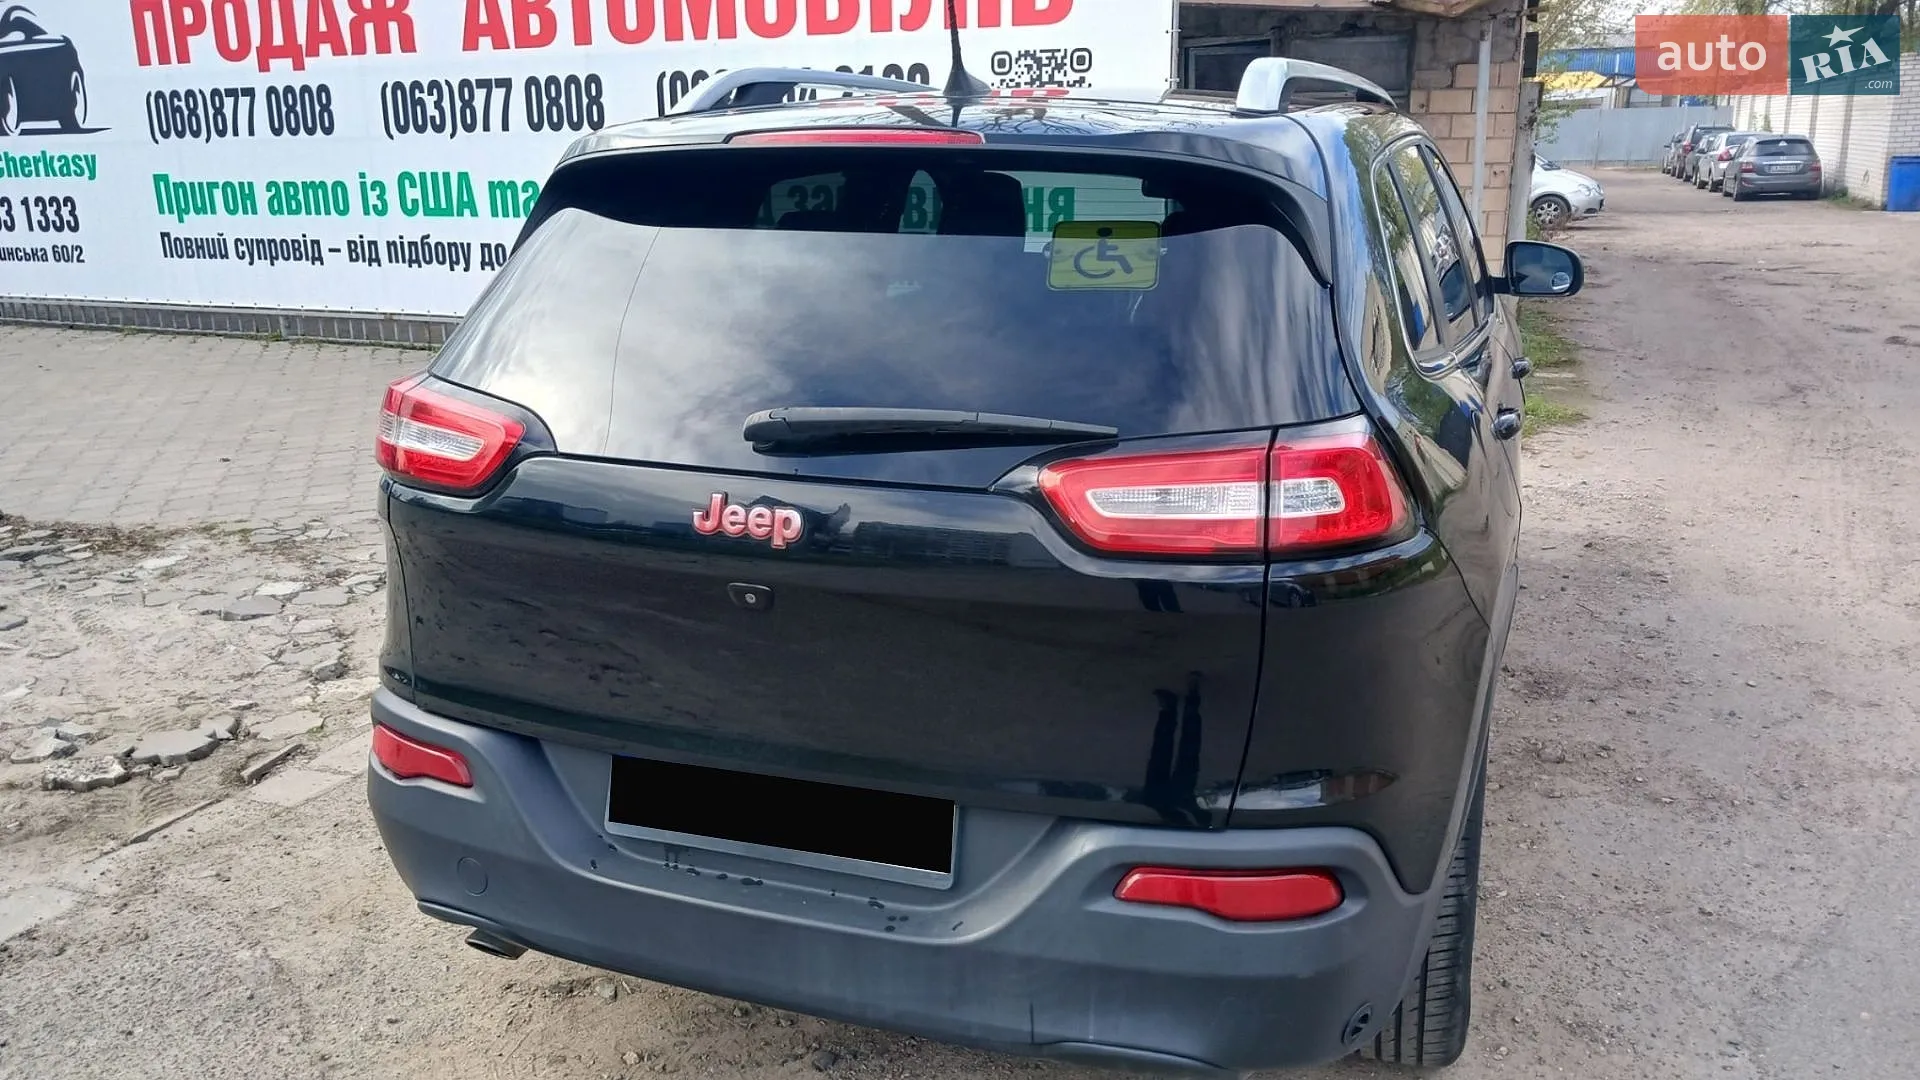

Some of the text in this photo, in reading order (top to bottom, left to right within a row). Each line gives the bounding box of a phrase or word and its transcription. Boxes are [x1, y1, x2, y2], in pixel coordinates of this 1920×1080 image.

[130, 0, 417, 72] ПРОДАЖ
[146, 83, 334, 144] (068)877 0808
[381, 77, 513, 140] (063)877
[524, 73, 605, 132] 0808
[20, 195, 80, 233] 1333
[152, 173, 258, 222] Пригон
[265, 179, 350, 216] авто
[358, 172, 388, 217] із
[397, 171, 479, 218] США
[51, 244, 85, 263] 60/2
[160, 231, 229, 260] Повний
[234, 233, 324, 266] супровід
[347, 235, 381, 268] від
[386, 235, 472, 272] підбору
[480, 243, 507, 271] до
[692, 491, 804, 549] Jeep
